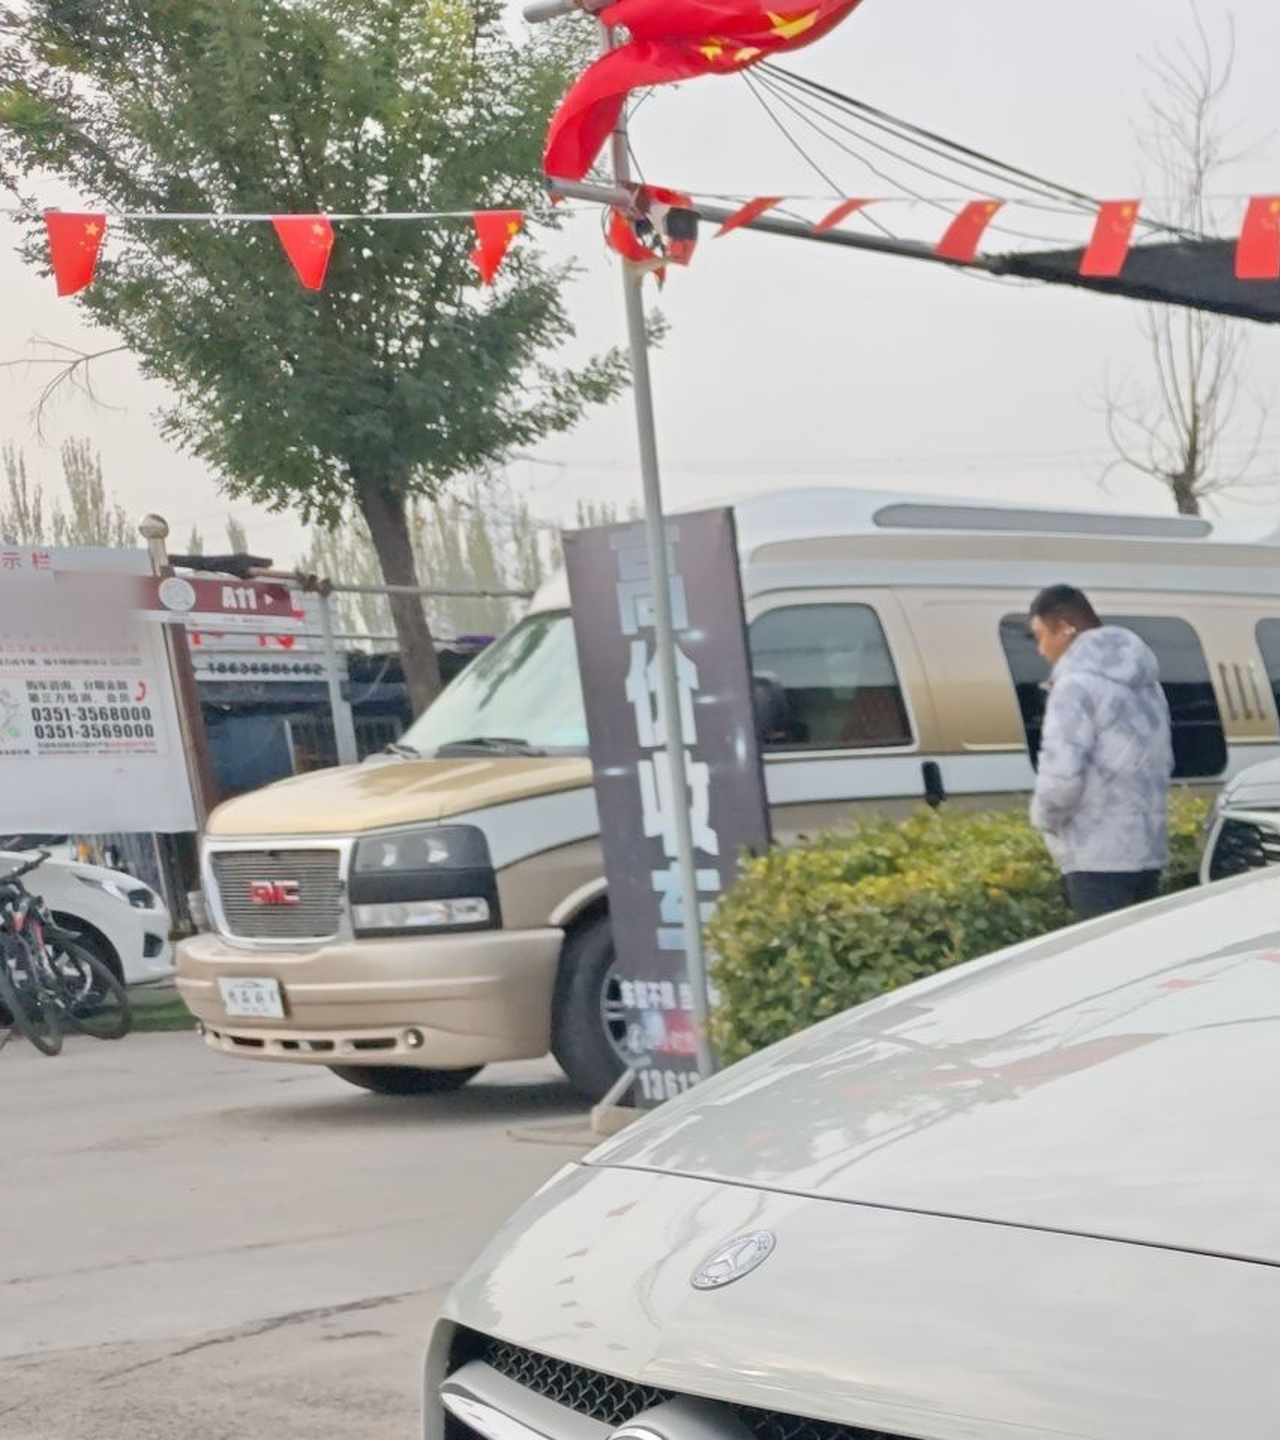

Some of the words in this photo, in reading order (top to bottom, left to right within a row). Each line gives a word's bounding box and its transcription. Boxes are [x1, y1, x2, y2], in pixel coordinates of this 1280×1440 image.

[2, 551, 52, 570] 示栏
[31, 707, 152, 722] 0351-3568000
[34, 724, 155, 739] 0351-3569000
[248, 880, 301, 906] GMC
